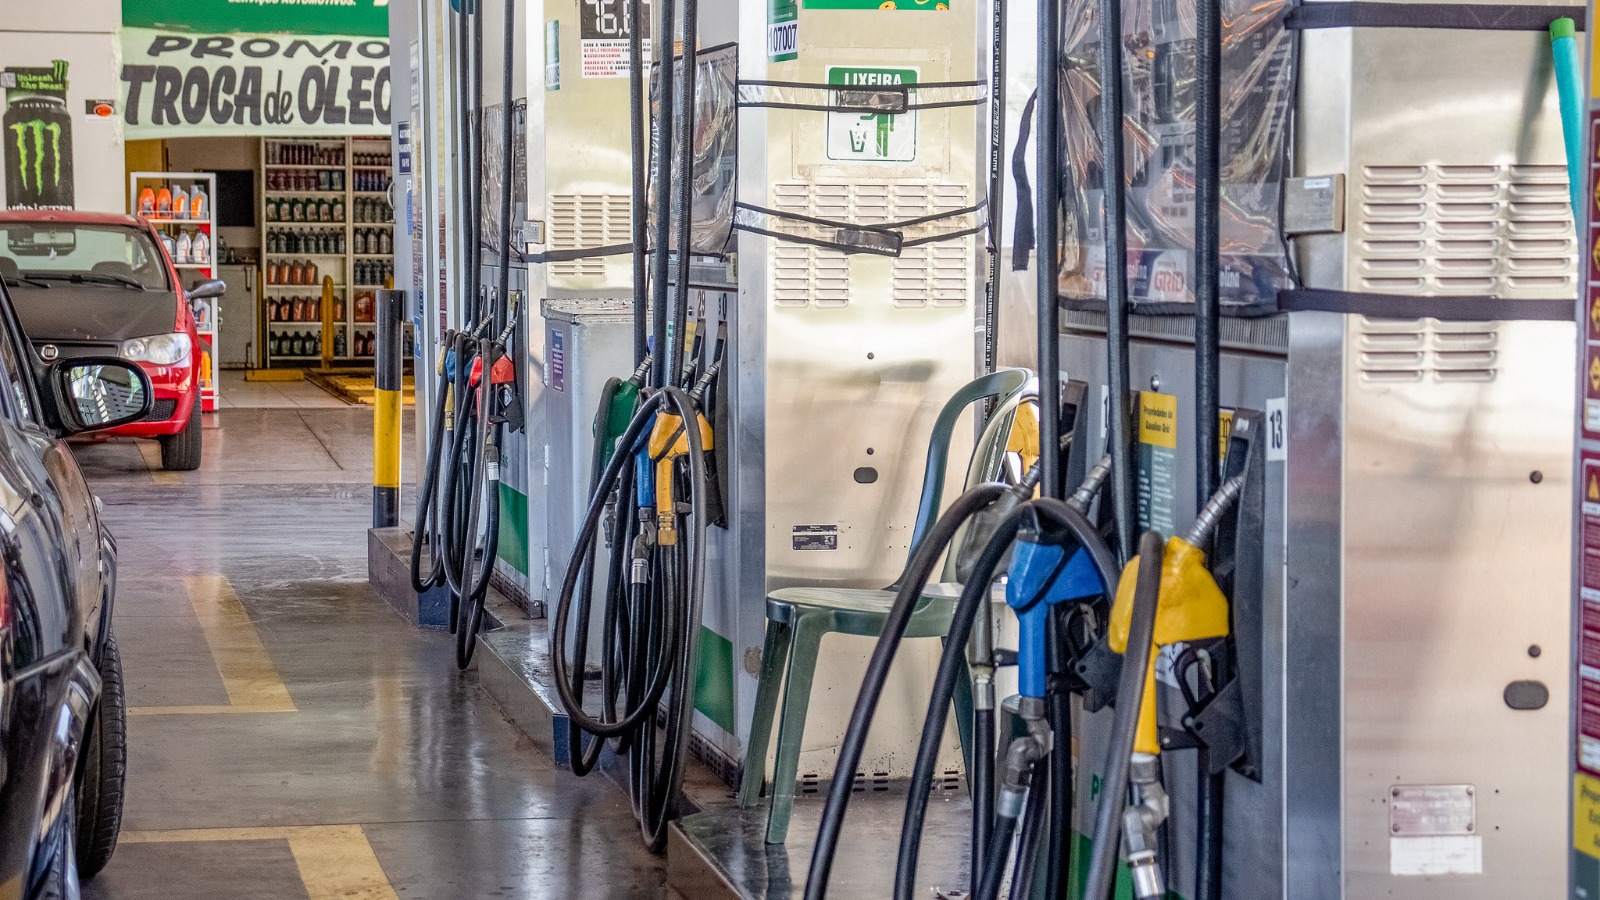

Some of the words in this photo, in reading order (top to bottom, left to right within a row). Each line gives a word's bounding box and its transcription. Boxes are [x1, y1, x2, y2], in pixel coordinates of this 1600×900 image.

[147, 36, 390, 59] PROMO
[769, 24, 797, 52] 107007
[120, 65, 262, 125] TROCA
[264, 69, 294, 124] de
[1270, 410, 1283, 449] 13
